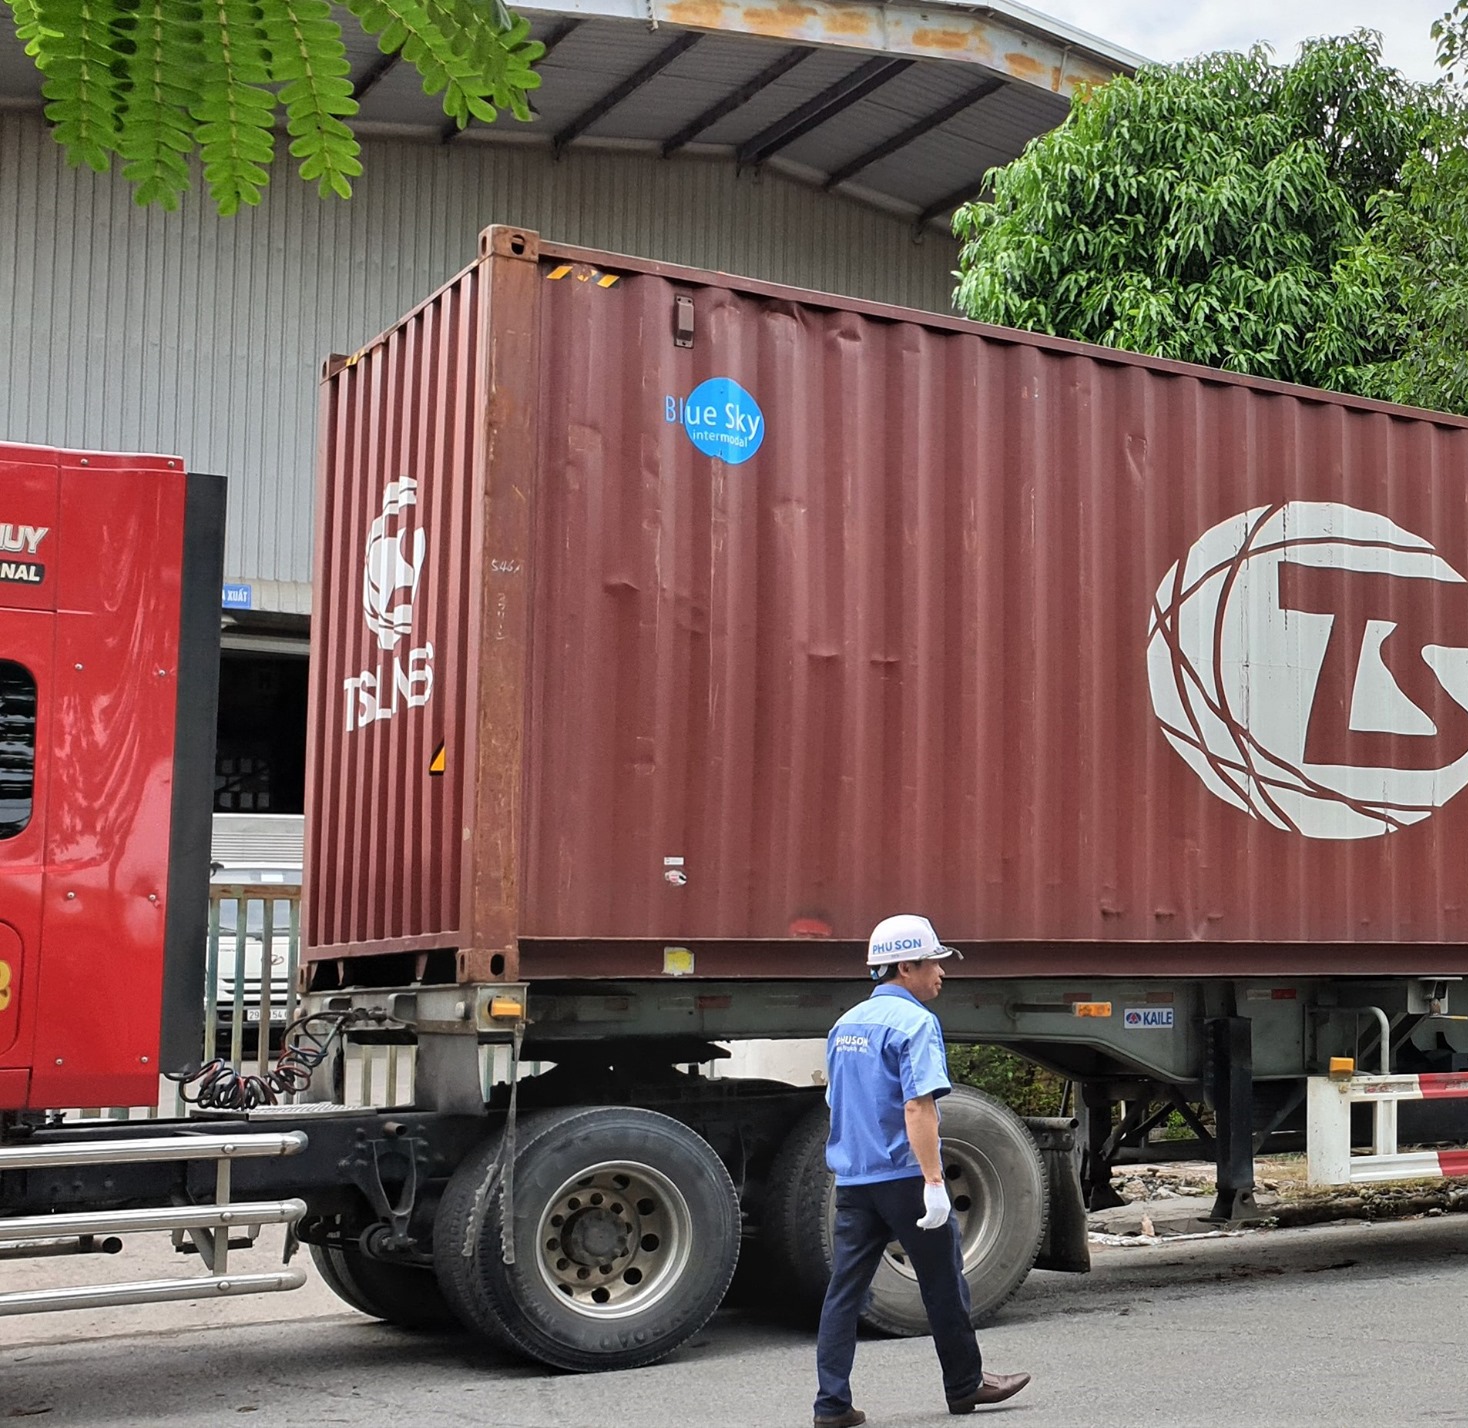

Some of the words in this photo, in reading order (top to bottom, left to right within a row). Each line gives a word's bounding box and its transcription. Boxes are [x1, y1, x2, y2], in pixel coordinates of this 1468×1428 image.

[664, 395, 718, 426] Blue
[724, 402, 761, 441] Sky
[692, 429, 748, 447] intermodal
[0, 562, 40, 581] NAL
[1143, 1011, 1172, 1026] KAILE
